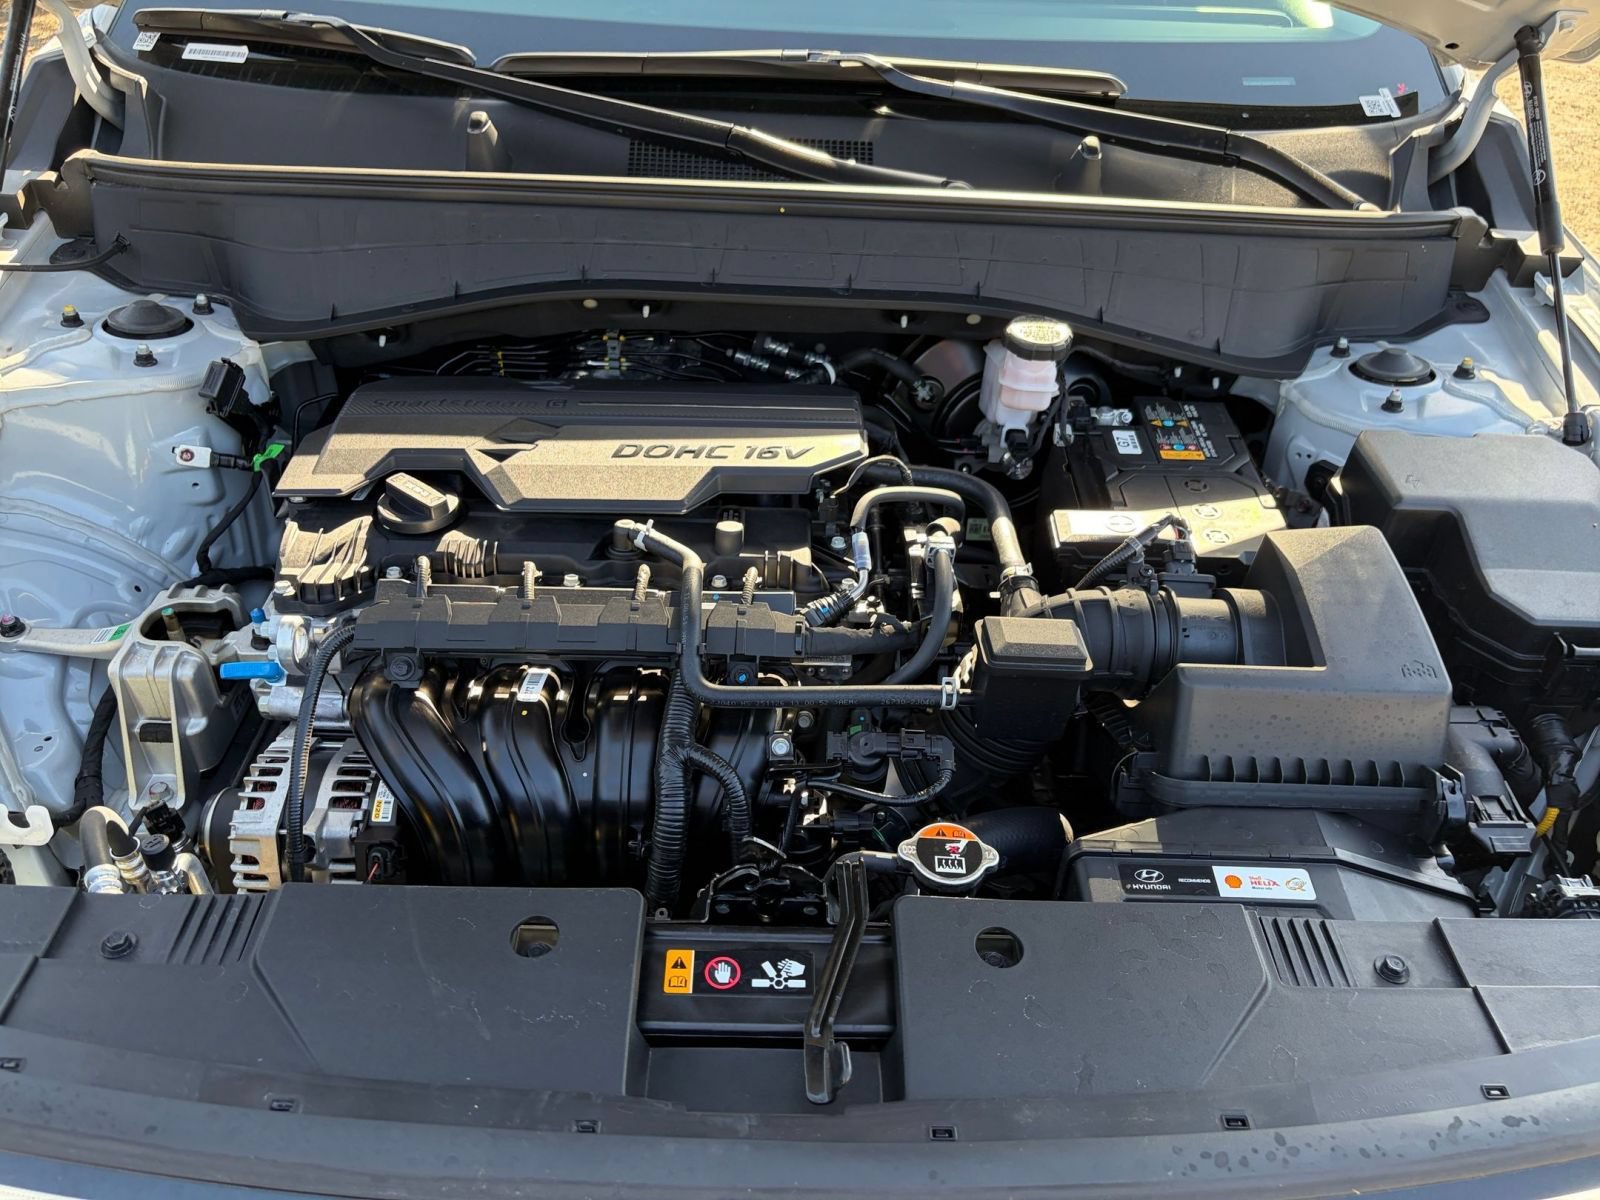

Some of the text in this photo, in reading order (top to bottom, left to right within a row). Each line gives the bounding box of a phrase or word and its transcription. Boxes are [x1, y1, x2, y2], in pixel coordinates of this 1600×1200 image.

[611, 444, 815, 460] DOHC 16V
[1250, 879, 1280, 887] HELIX
